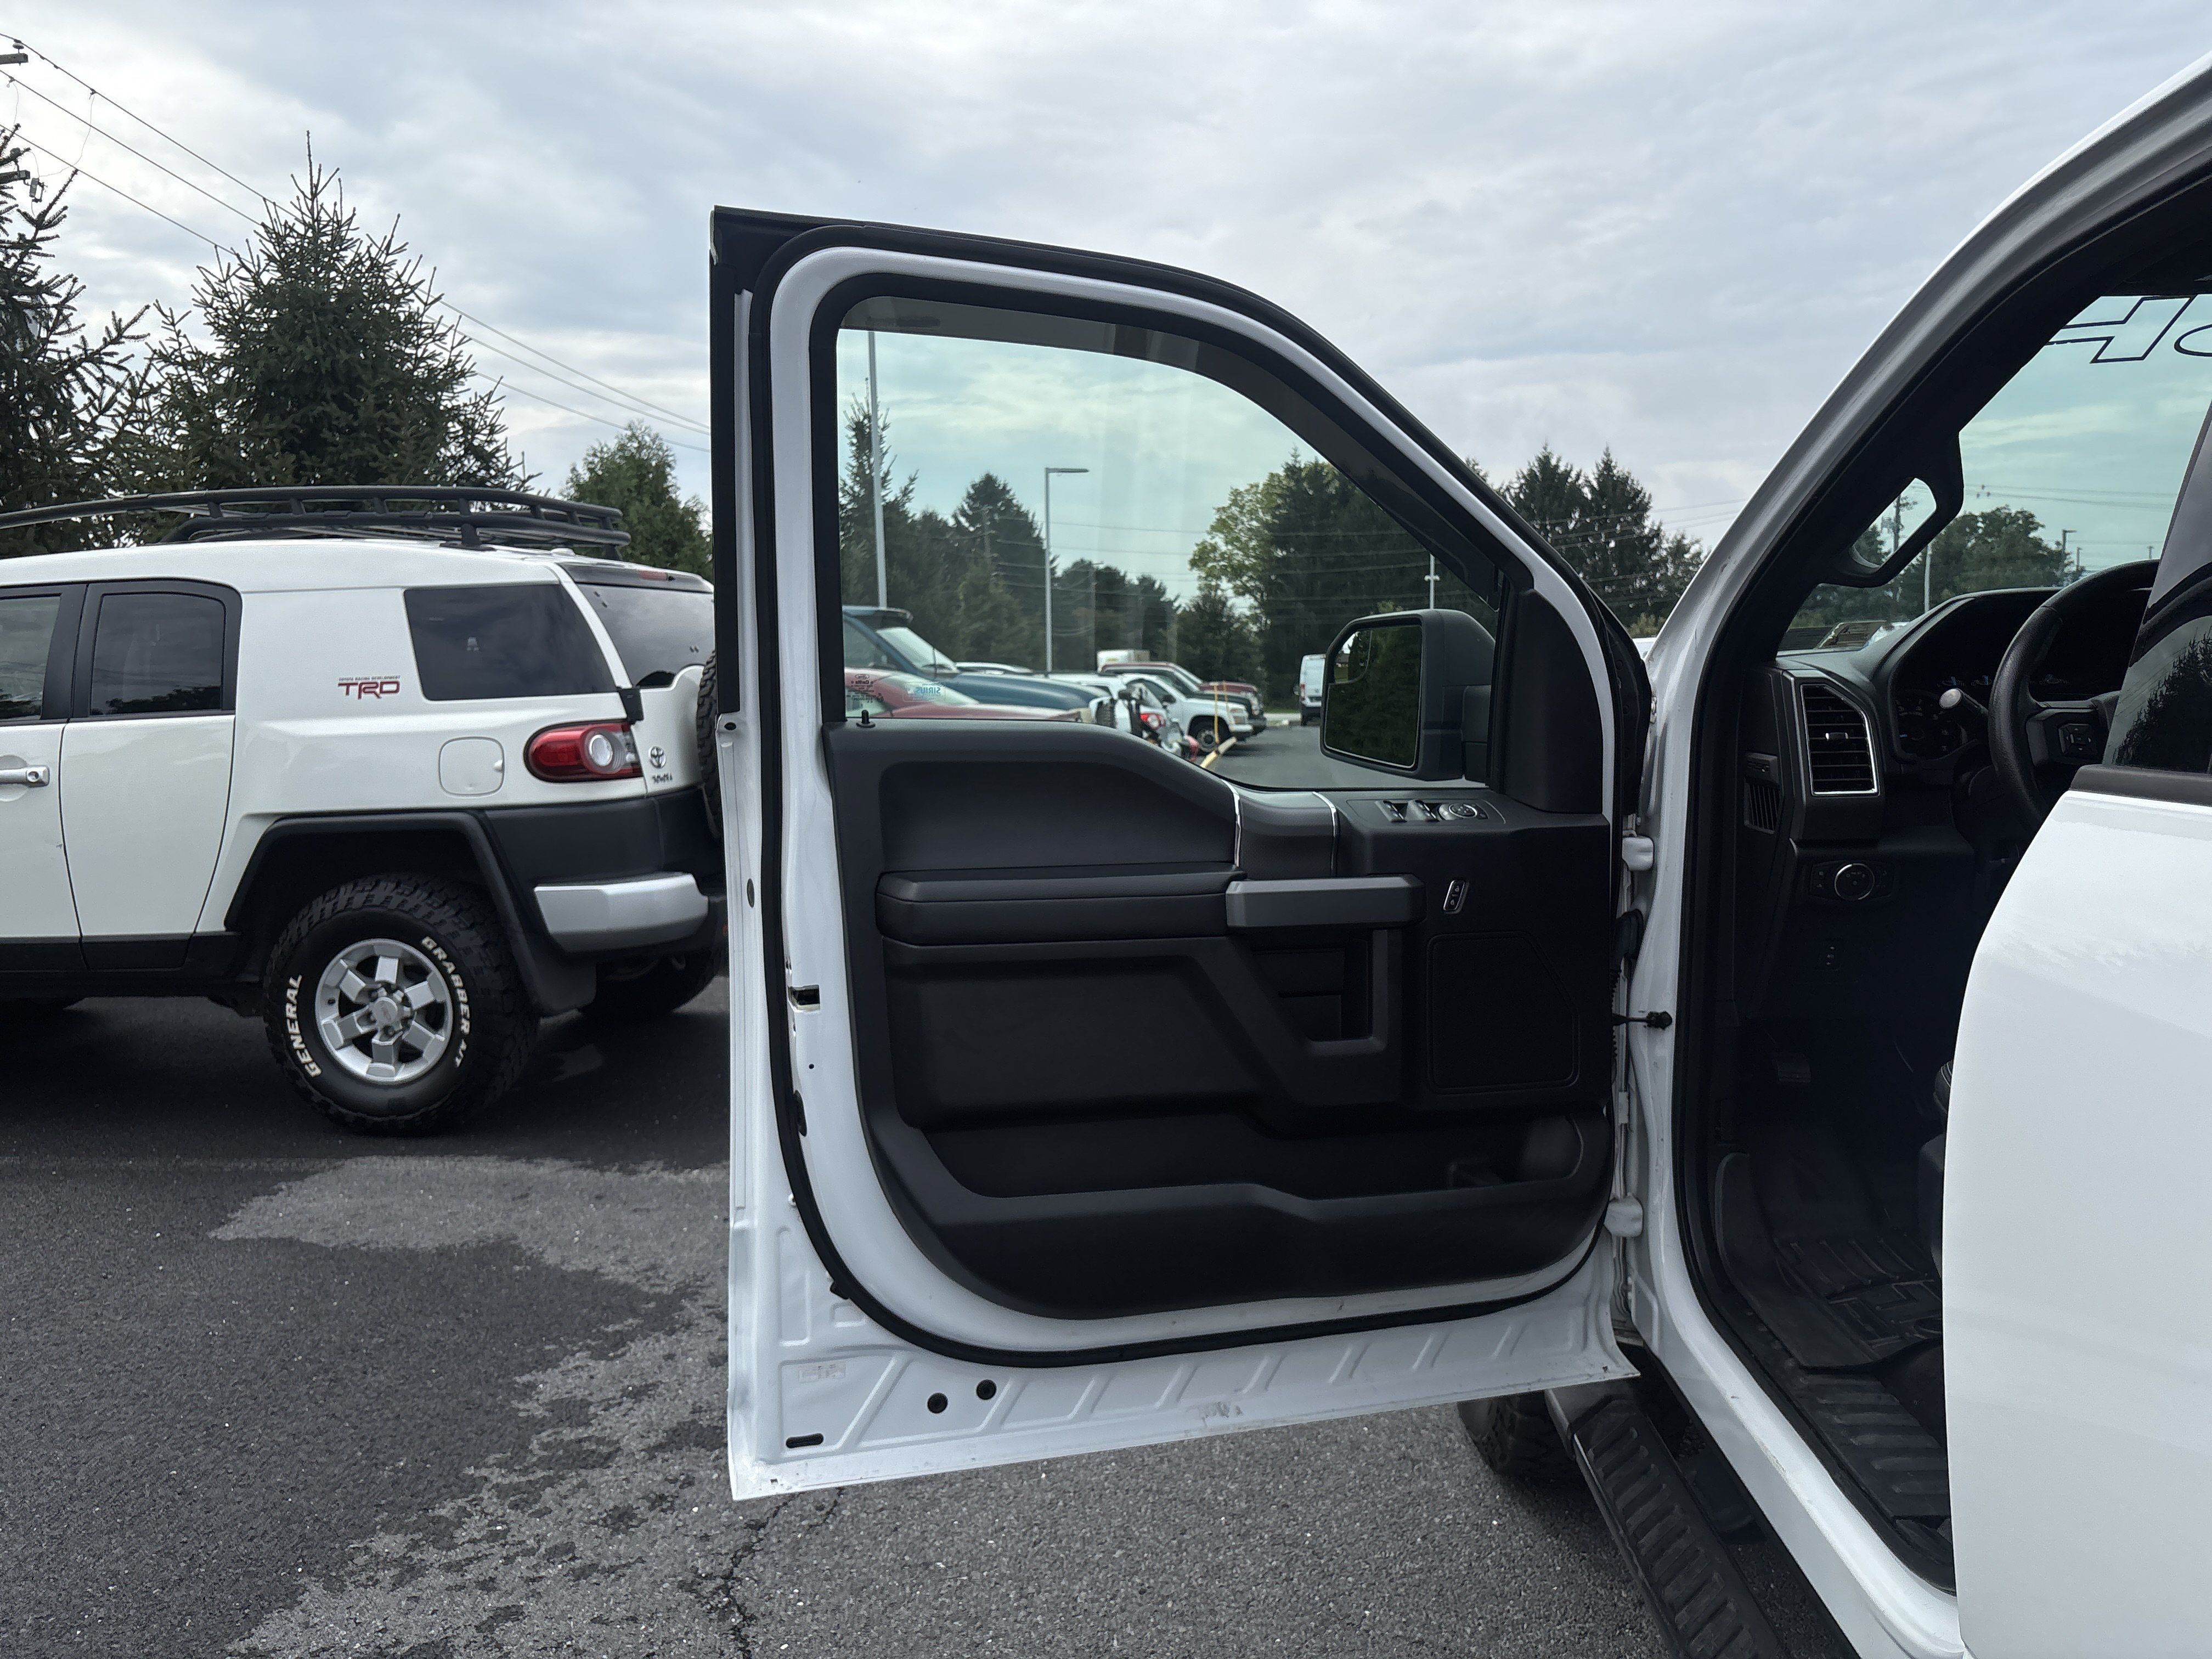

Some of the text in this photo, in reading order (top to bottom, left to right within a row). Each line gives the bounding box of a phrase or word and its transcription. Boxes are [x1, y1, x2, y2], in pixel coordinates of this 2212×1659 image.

[338, 681, 400, 699] TRD
[285, 974, 322, 1077] GENERAL
[420, 936, 471, 1036] GRABBER
